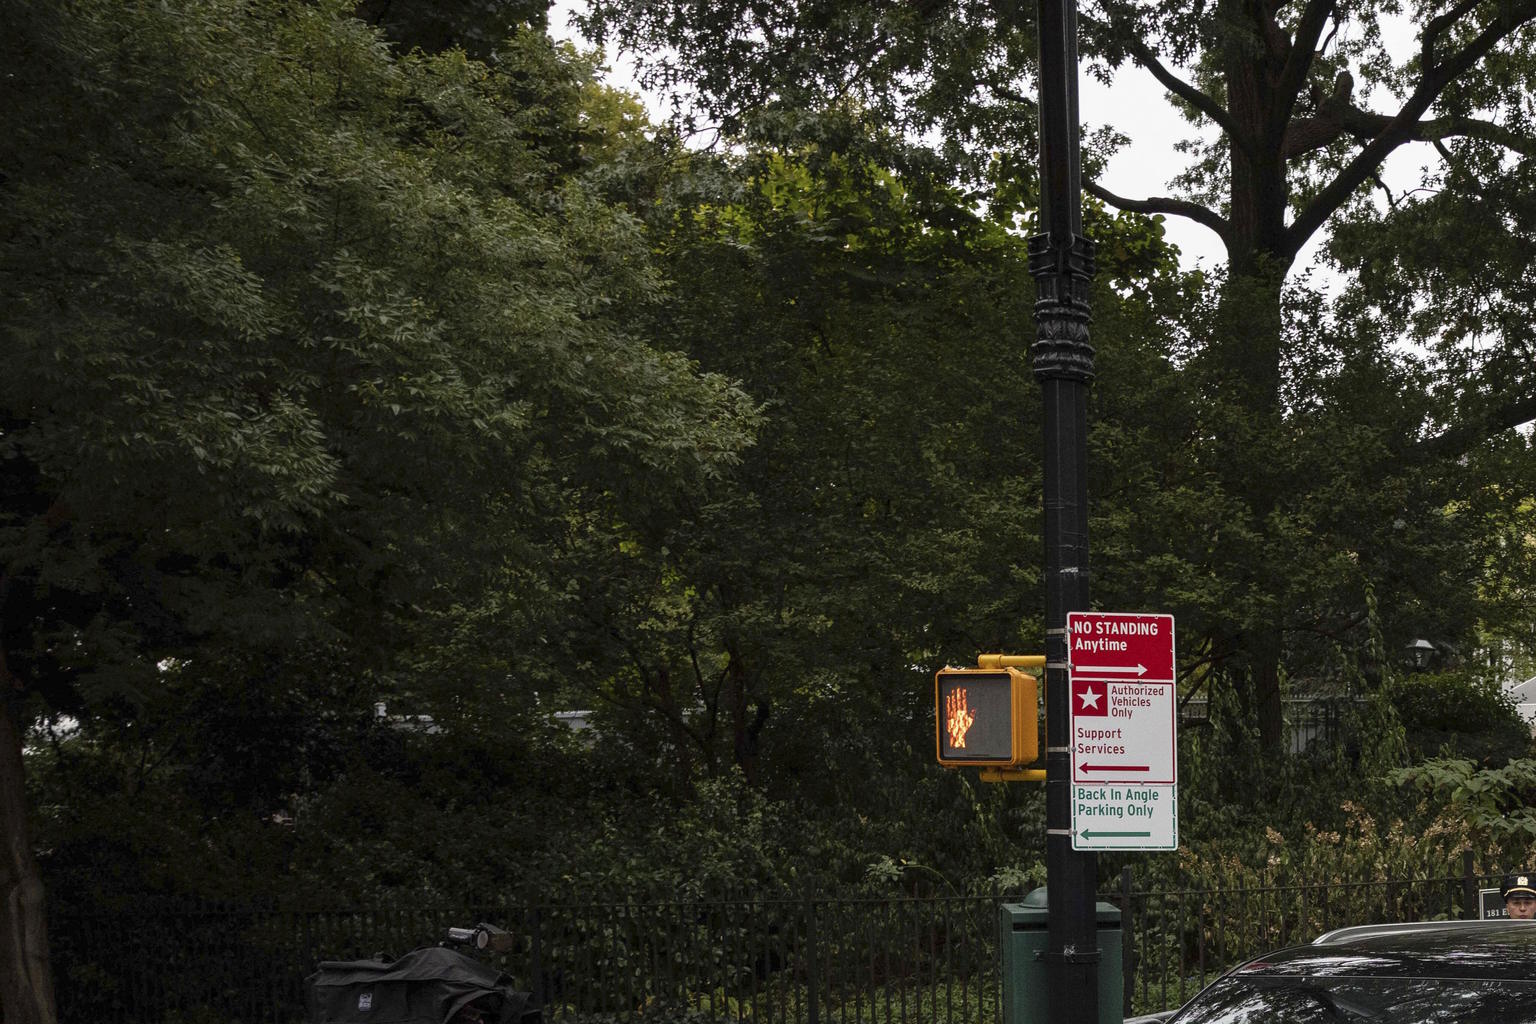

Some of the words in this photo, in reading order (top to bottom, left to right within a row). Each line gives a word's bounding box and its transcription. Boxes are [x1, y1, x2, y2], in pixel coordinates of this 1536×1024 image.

[1074, 621, 1092, 634] NO
[1096, 622, 1159, 636] STANDING
[1075, 638, 1128, 653] Anytime
[1111, 685, 1164, 696] Authorized
[1111, 696, 1151, 707] Vehicles
[1111, 707, 1133, 720] Only
[1077, 728, 1122, 741] Support
[1077, 743, 1125, 755] Services
[1078, 788, 1106, 801] Back
[1111, 788, 1122, 800] In
[1126, 788, 1159, 803] Angle
[1078, 803, 1123, 819] Parking
[1127, 804, 1154, 819] Only
[1487, 909, 1500, 917] 181
